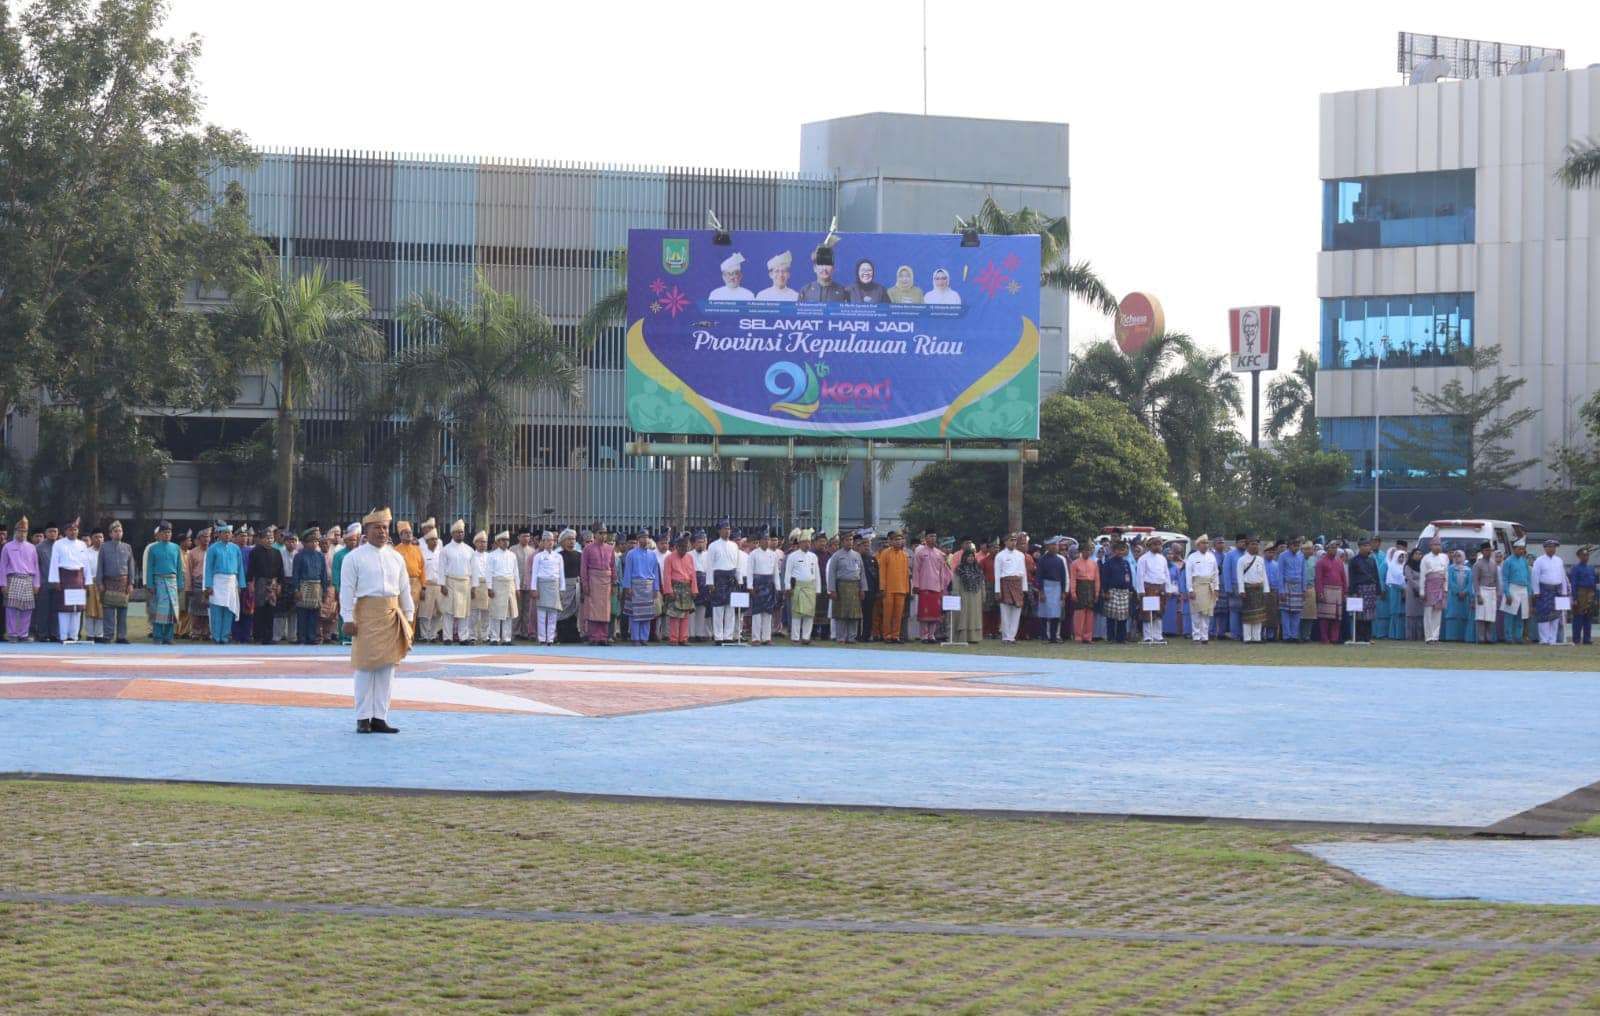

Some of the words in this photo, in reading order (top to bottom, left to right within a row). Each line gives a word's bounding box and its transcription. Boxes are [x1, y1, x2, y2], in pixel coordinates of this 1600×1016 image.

[739, 319, 823, 331] SELAMAT
[828, 320, 870, 332] HARI
[875, 321, 914, 333] JADI
[692, 330, 783, 352] Provinsi
[785, 331, 907, 358] Kepulauan
[912, 334, 964, 355] Riau
[1237, 354, 1262, 368] KFC
